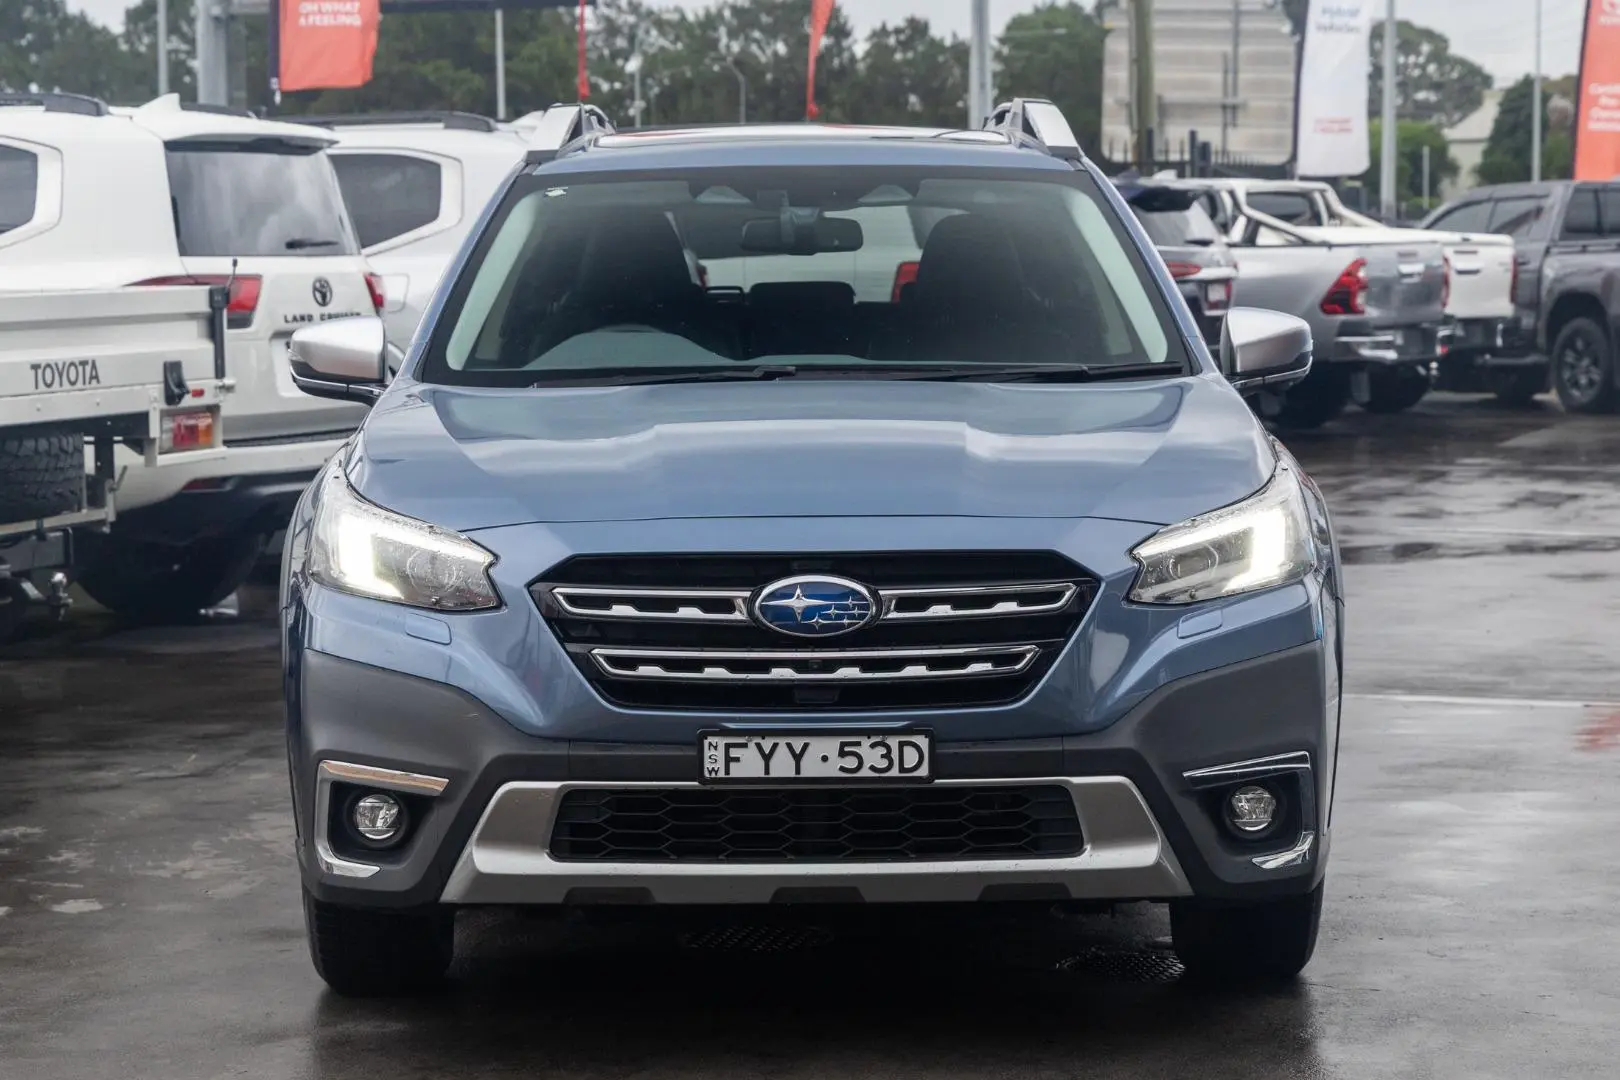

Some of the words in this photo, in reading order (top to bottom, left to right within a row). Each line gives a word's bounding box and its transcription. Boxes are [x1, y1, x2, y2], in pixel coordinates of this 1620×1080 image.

[319, 1, 360, 13] WHAT
[308, 13, 362, 27] FEELING
[283, 313, 314, 324] LAND
[30, 359, 100, 390] TOYOTA
[706, 741, 720, 777] NSW
